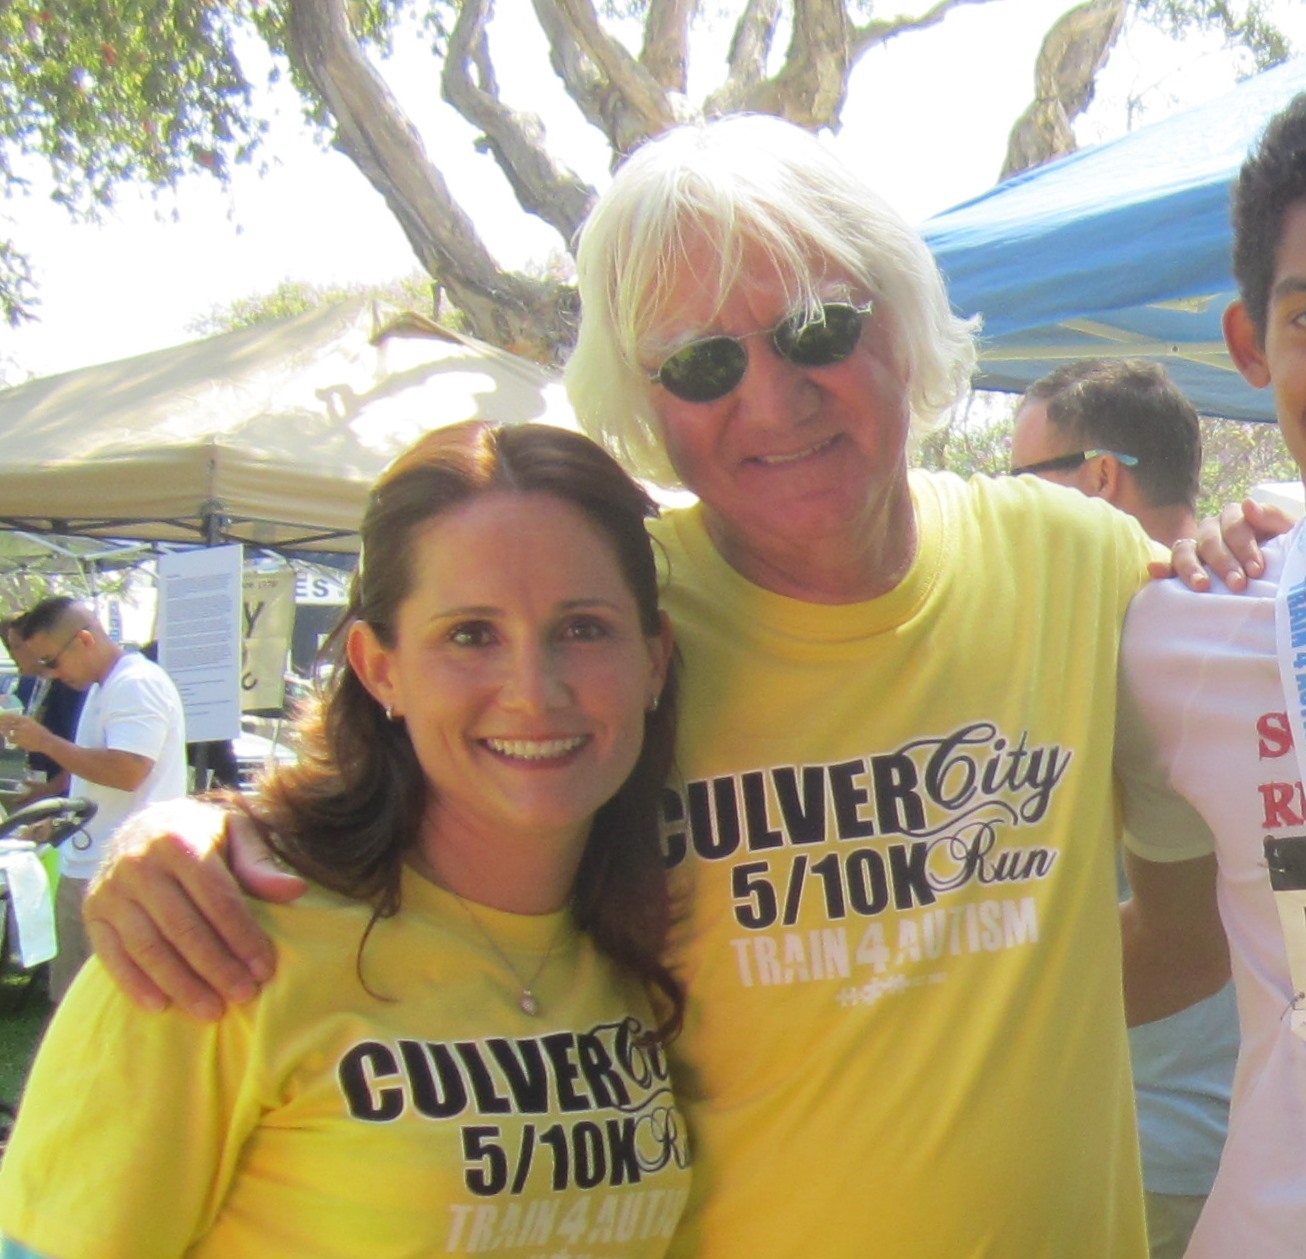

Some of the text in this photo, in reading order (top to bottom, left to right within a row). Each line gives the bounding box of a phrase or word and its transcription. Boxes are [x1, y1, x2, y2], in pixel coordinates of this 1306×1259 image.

[912, 722, 1072, 824] City
[732, 820, 1057, 930] 5/10K Run
[730, 896, 1040, 988] TRAIN 4 AUTISM
[338, 1016, 669, 1123] CULVER Ci
[462, 1116, 642, 1197] 5/10K
[445, 1199, 560, 1253] TRAIN
[557, 1195, 592, 1245] 4
